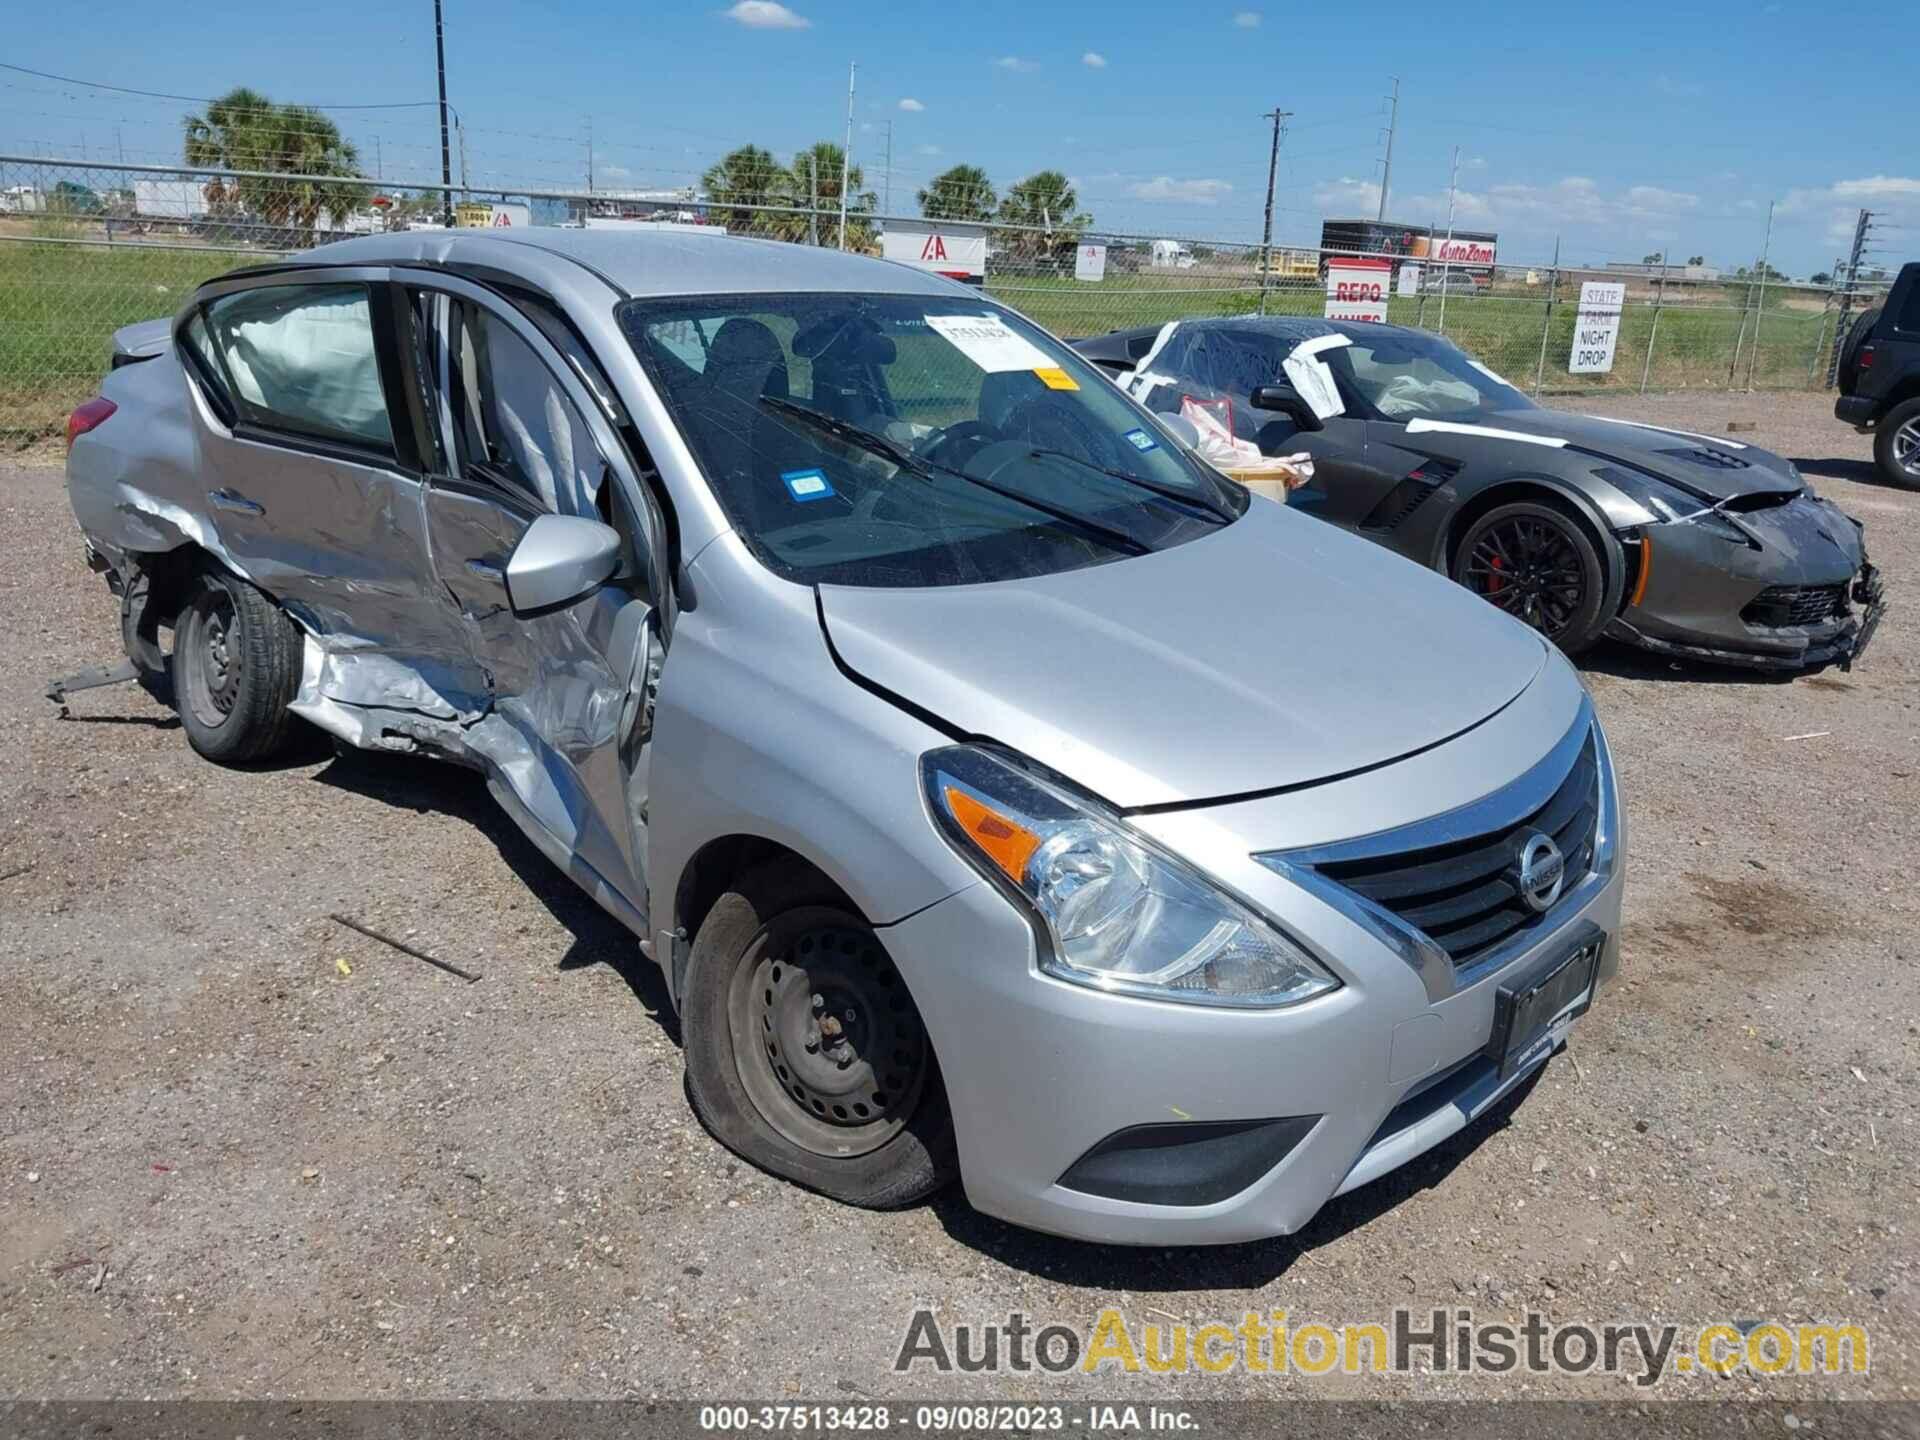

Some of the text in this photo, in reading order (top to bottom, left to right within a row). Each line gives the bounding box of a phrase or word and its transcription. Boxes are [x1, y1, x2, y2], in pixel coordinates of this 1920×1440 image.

[1438, 238, 1493, 261] AutoZone
[1336, 282, 1381, 303] REPO
[1586, 289, 1618, 304] STATE
[1580, 330, 1611, 345] NIGHT
[1577, 350, 1607, 366] DROP
